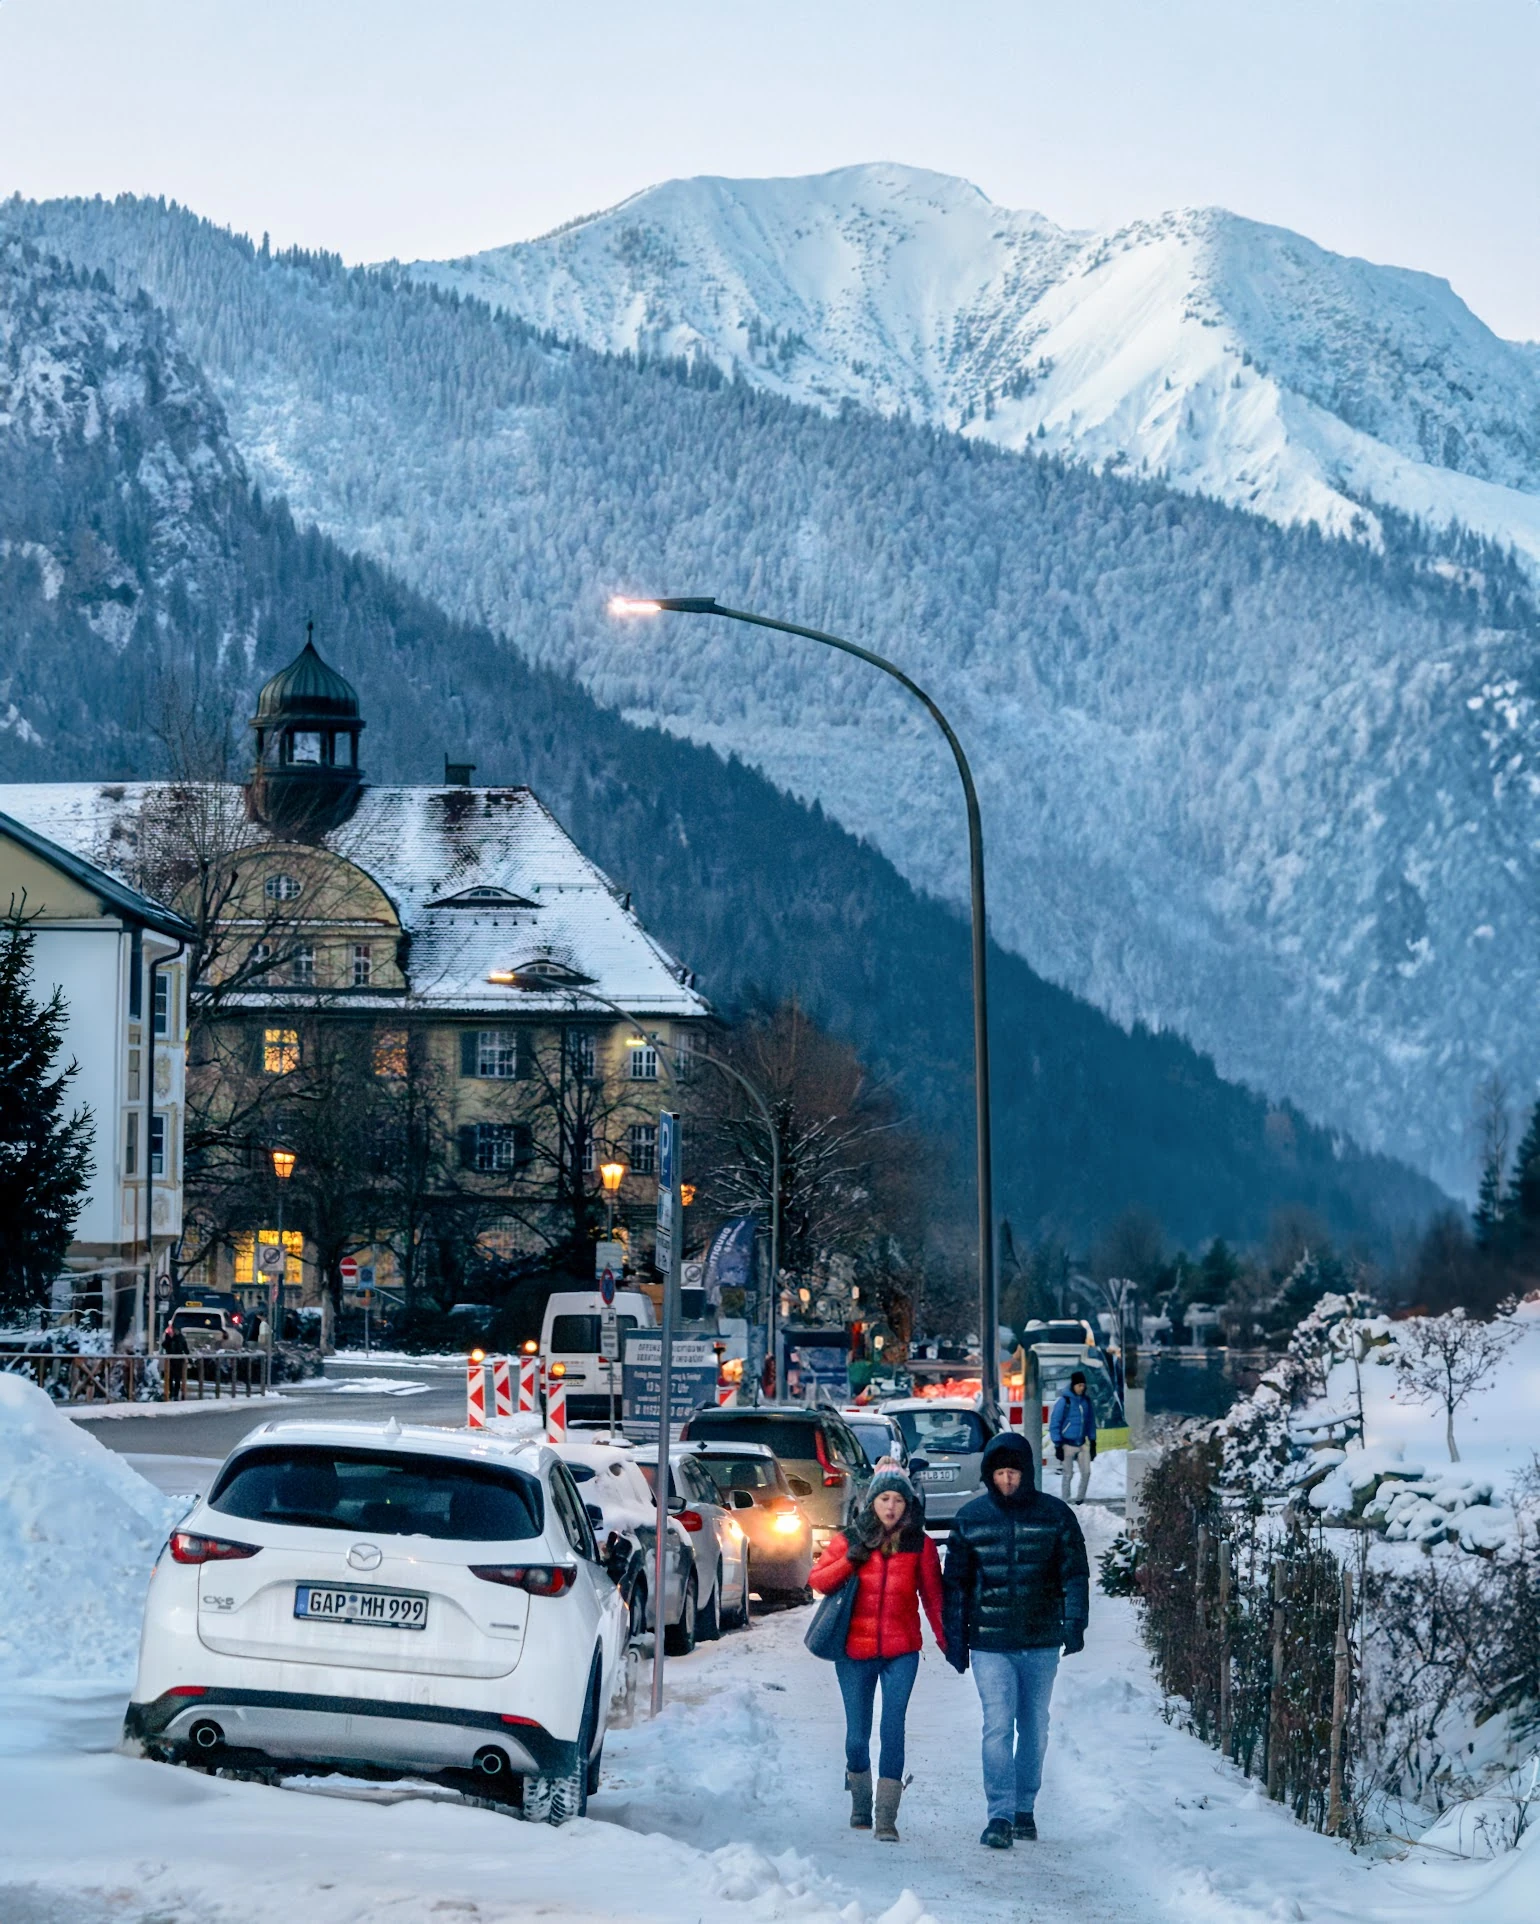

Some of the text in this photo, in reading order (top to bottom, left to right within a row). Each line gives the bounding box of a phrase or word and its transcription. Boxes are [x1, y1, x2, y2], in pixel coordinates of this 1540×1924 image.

[661, 1122, 669, 1176] P
[309, 1591, 424, 1621] GAP MH 999
